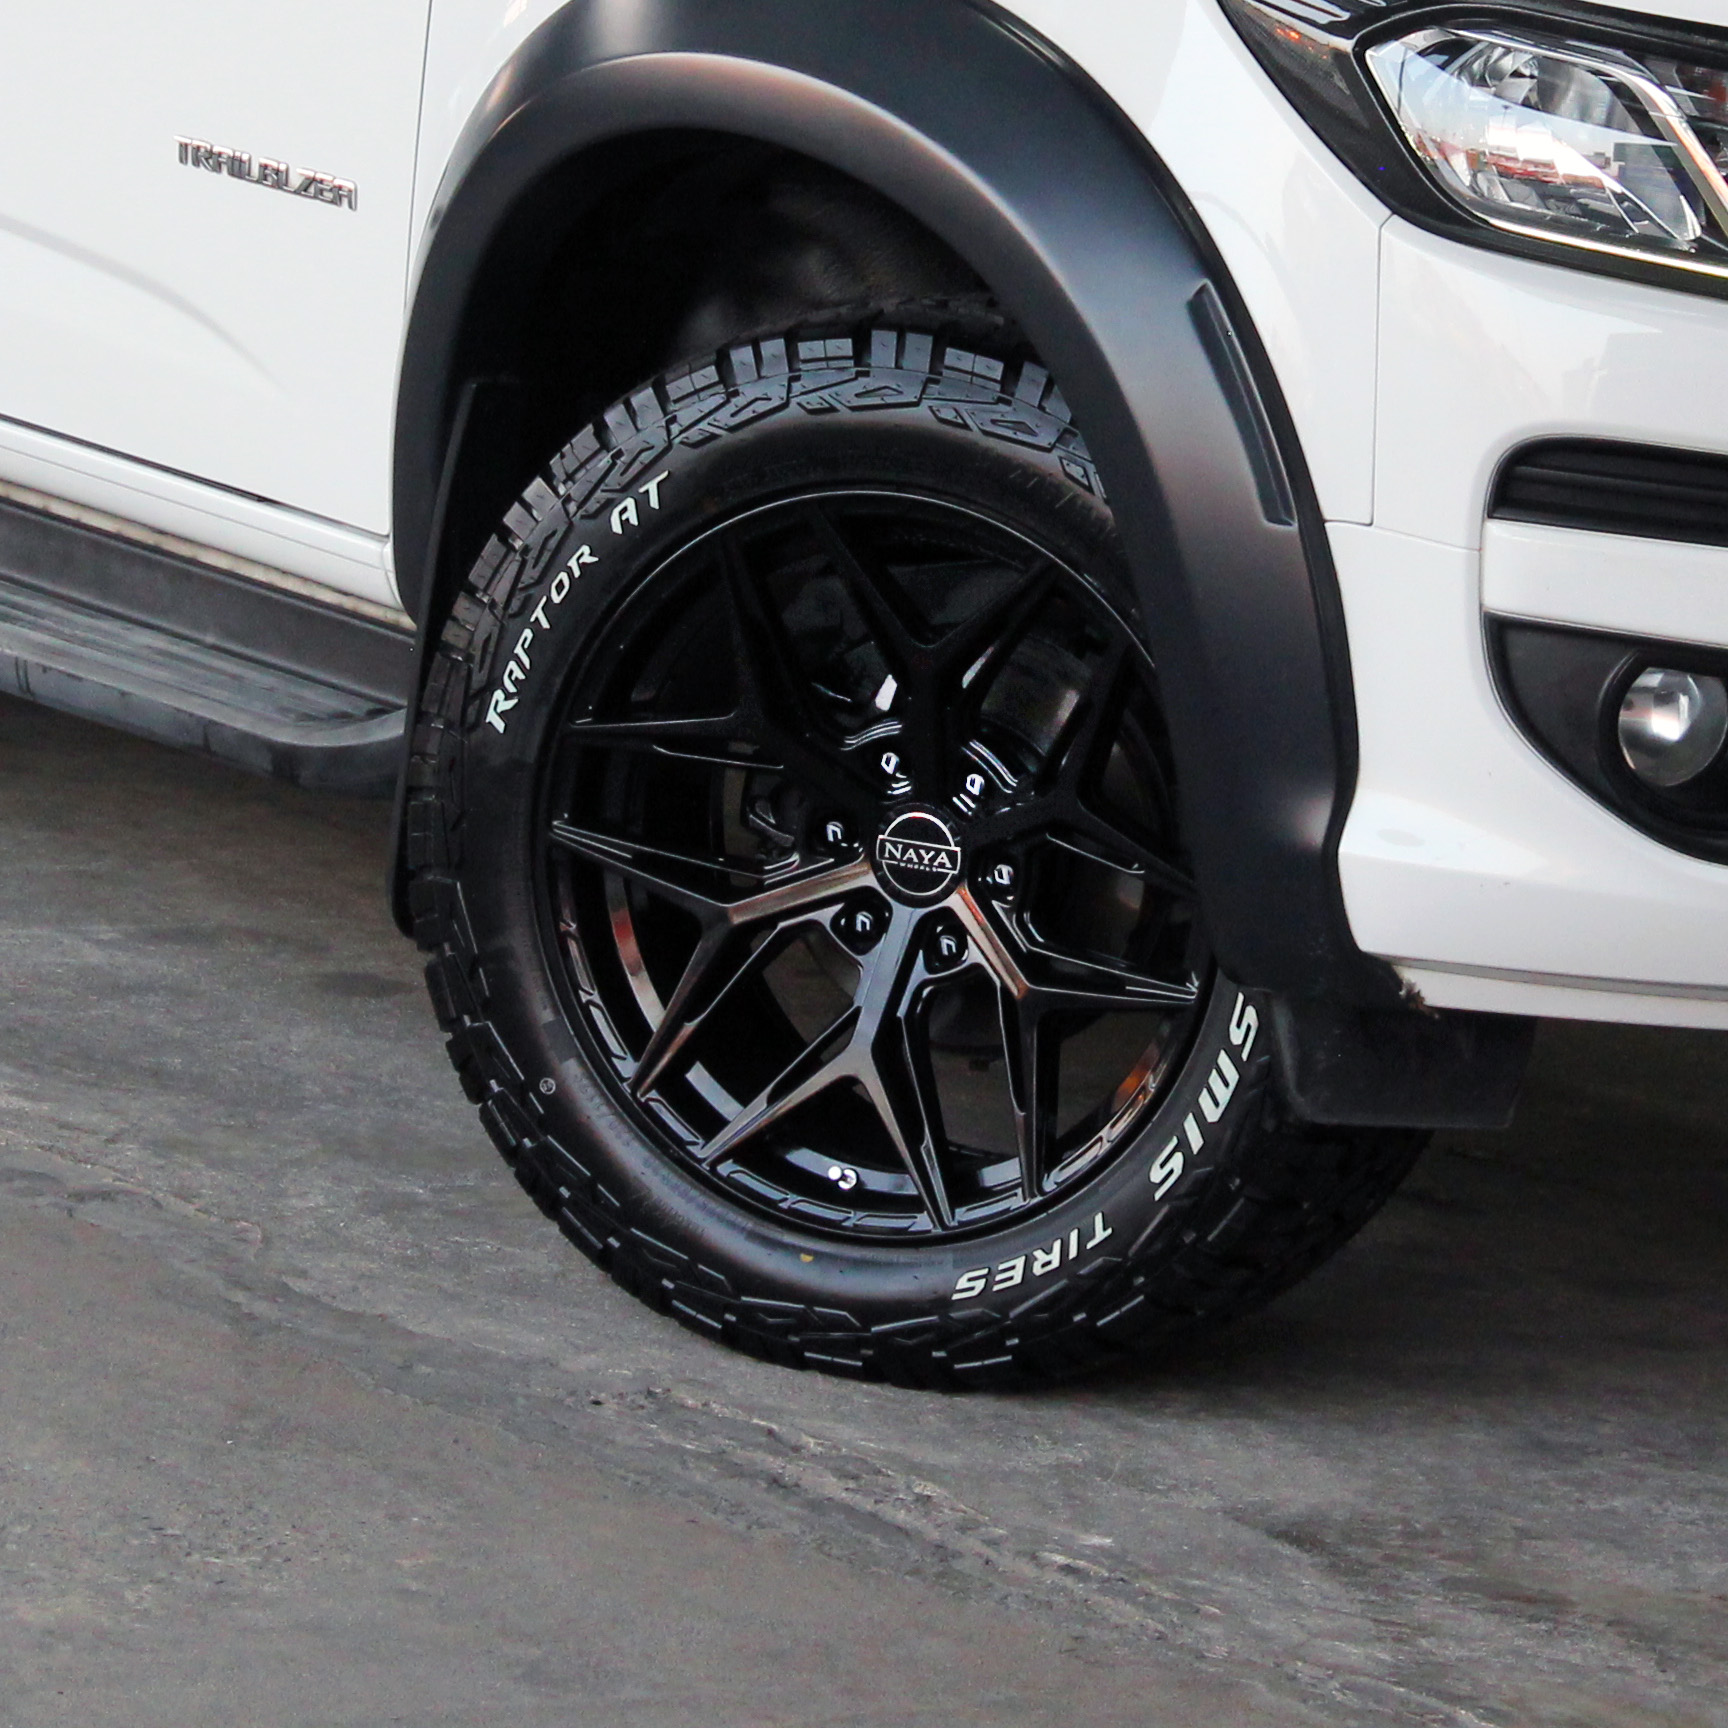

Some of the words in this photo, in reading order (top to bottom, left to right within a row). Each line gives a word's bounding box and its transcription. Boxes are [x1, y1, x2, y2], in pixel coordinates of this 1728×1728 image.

[485, 544, 599, 734] RAPTOR
[609, 469, 670, 535] AT
[883, 841, 953, 869] NAYA
[950, 1210, 1113, 1301] TIRES
